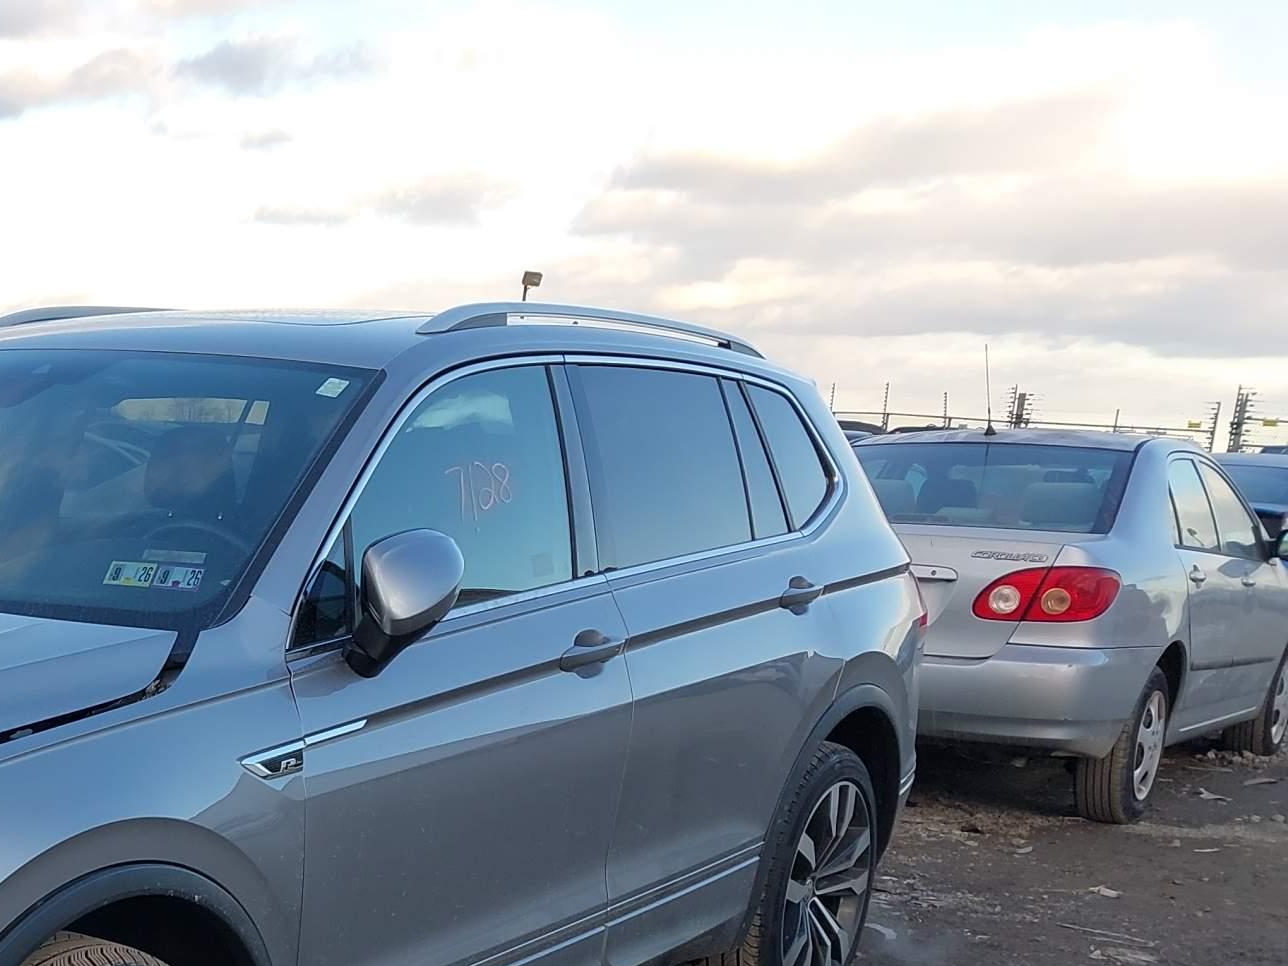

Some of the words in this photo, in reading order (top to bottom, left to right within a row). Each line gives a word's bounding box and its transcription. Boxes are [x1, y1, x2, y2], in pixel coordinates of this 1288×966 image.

[112, 567, 122, 581] 9
[138, 566, 154, 582] 26
[160, 570, 170, 584] 9
[187, 569, 202, 586] 26
